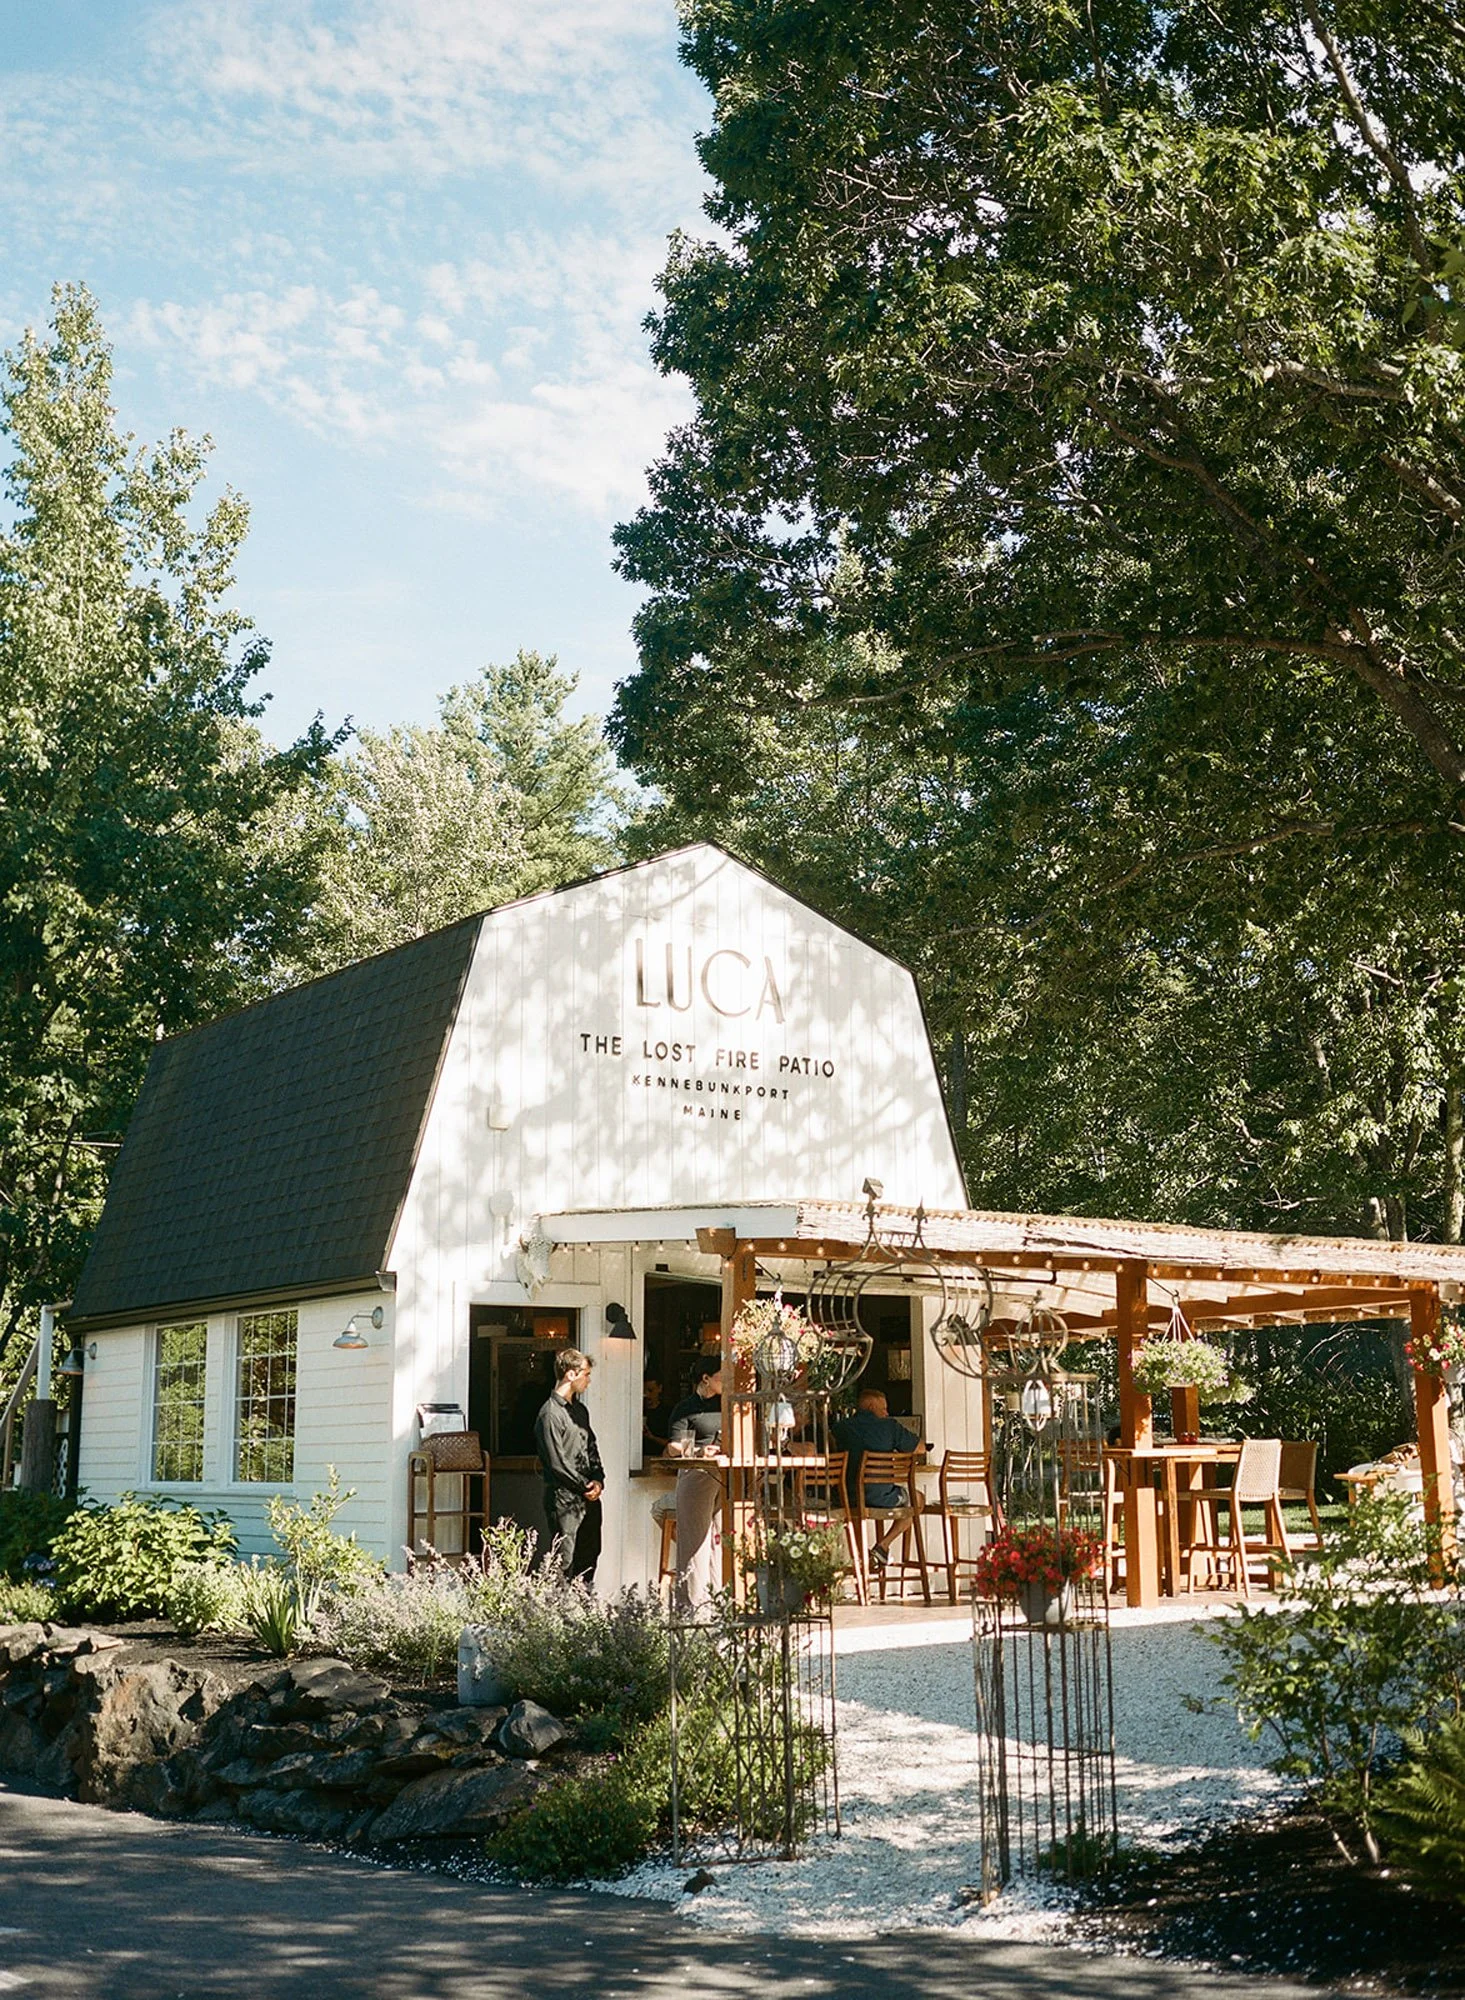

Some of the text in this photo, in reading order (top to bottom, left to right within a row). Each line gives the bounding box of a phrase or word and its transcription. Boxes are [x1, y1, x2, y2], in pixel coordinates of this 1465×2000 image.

[635, 937, 786, 1025] LUCA
[580, 1033, 835, 1078] THE LOST FIRE PATIO
[631, 1074, 789, 1100] KENNEBUNKPORT
[683, 1105, 741, 1120] MAINE
